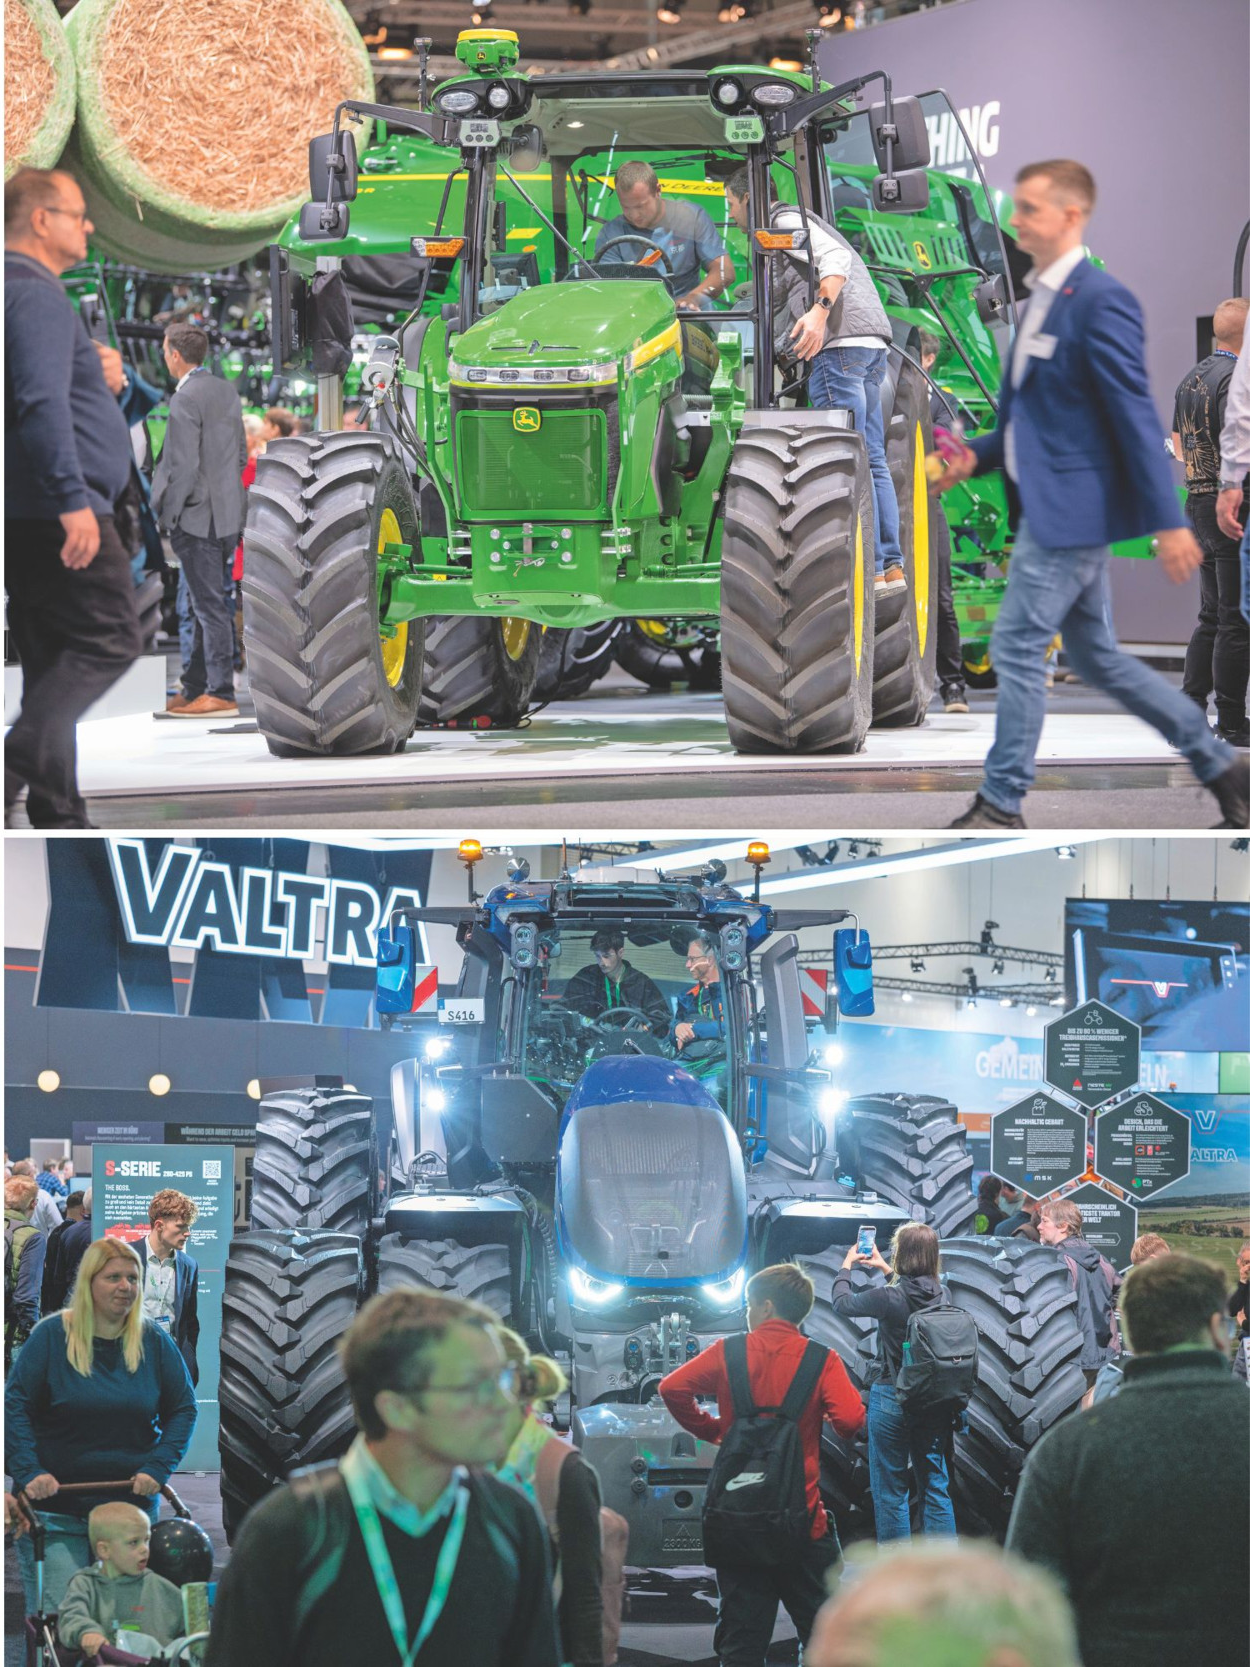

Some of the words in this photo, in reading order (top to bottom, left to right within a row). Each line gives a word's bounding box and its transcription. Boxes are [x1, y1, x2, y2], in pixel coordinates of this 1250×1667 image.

[924, 100, 1001, 168] HING
[671, 183, 724, 192] DEERE
[104, 837, 432, 968] VALTRA
[447, 1010, 475, 1021] S416
[975, 1051, 1043, 1081] GEMEIN
[1140, 1063, 1167, 1088] ELN
[180, 1126, 204, 1135] WÄHREND
[215, 1128, 231, 1136] ARBEIT
[1191, 1149, 1238, 1162] ALTRA
[105, 1160, 161, 1177] S-SERIE
